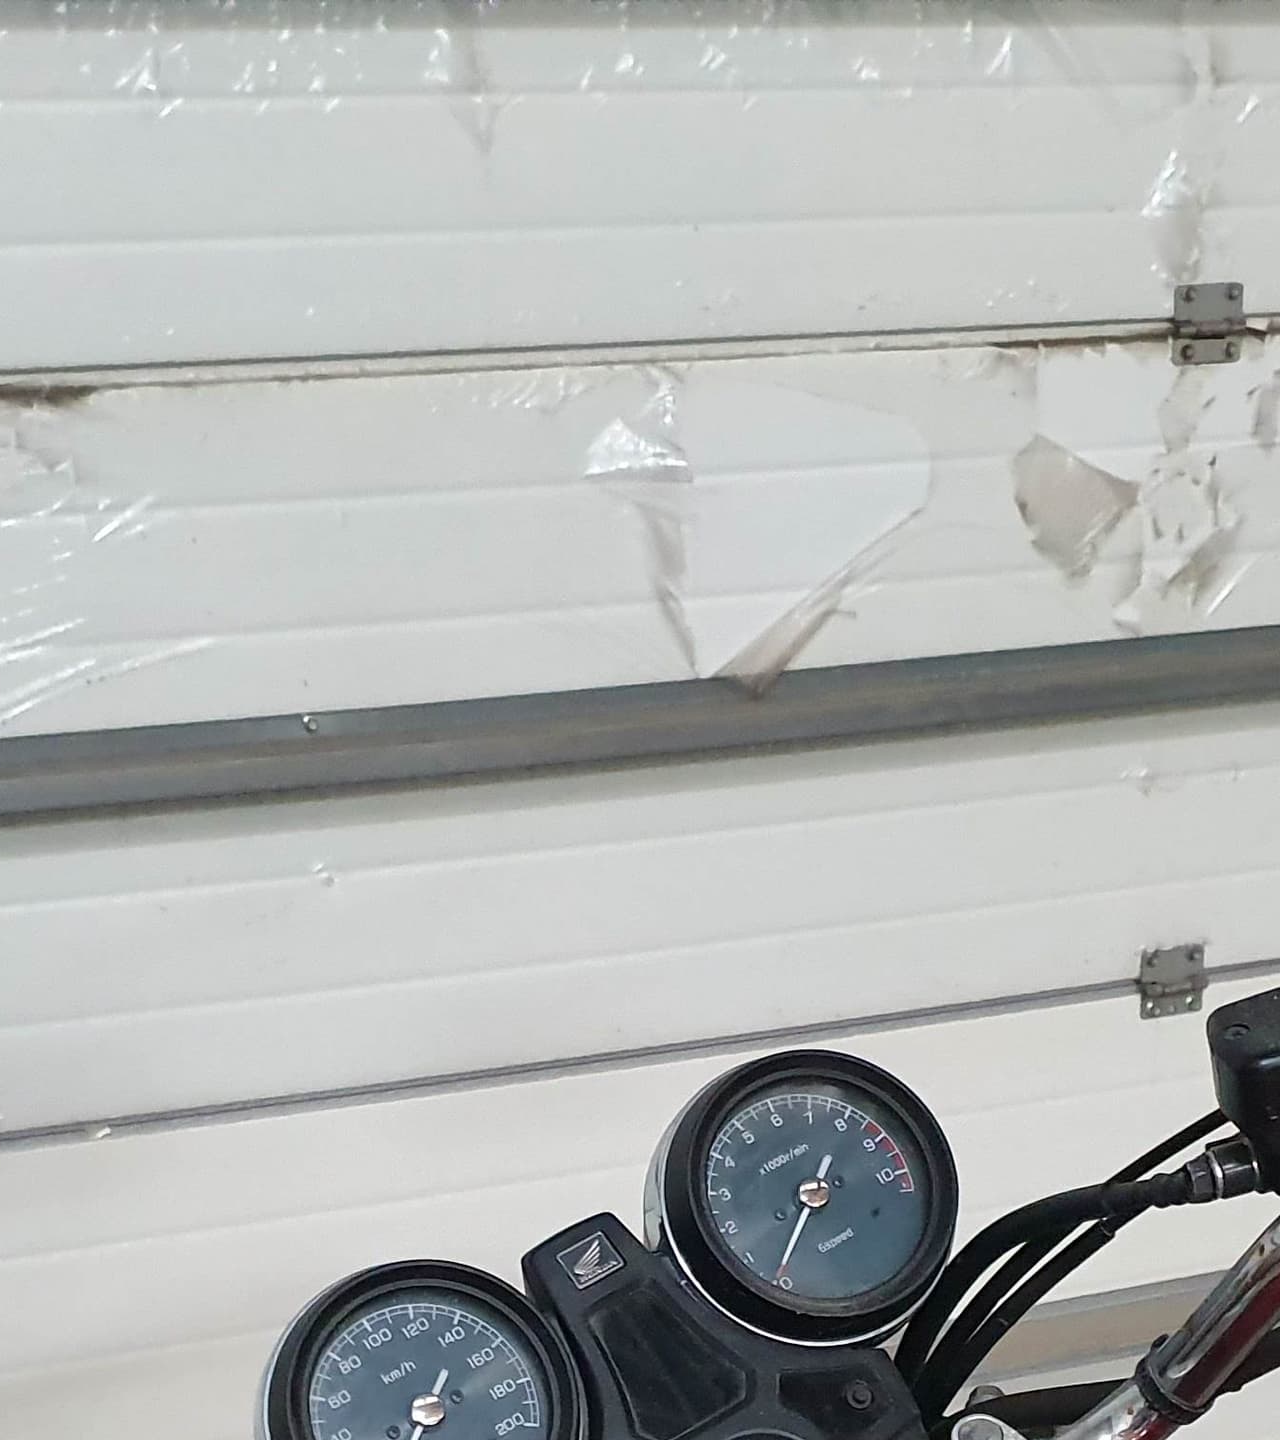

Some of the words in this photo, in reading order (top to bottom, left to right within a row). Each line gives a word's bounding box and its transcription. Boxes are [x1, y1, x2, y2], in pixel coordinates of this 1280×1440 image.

[771, 1113, 783, 1127] 6
[803, 1112, 813, 1124] 7
[834, 1118, 847, 1132] 8
[743, 1130, 755, 1144] 5
[863, 1138, 875, 1152] 9
[724, 1157, 735, 1168] 4
[876, 1167, 895, 1184] 10
[719, 1188, 731, 1201] 3
[726, 1221, 737, 1233] 2
[745, 1253, 754, 1263] 1
[780, 1277, 793, 1290] 0
[403, 1318, 430, 1339] 120
[363, 1328, 392, 1351] 100
[438, 1327, 466, 1347] 140
[338, 1355, 362, 1375] 80
[467, 1347, 494, 1368] 160
[381, 1360, 416, 1385] km/h
[489, 1379, 516, 1400] 180
[327, 1390, 351, 1409] 60
[495, 1413, 524, 1436] 200
